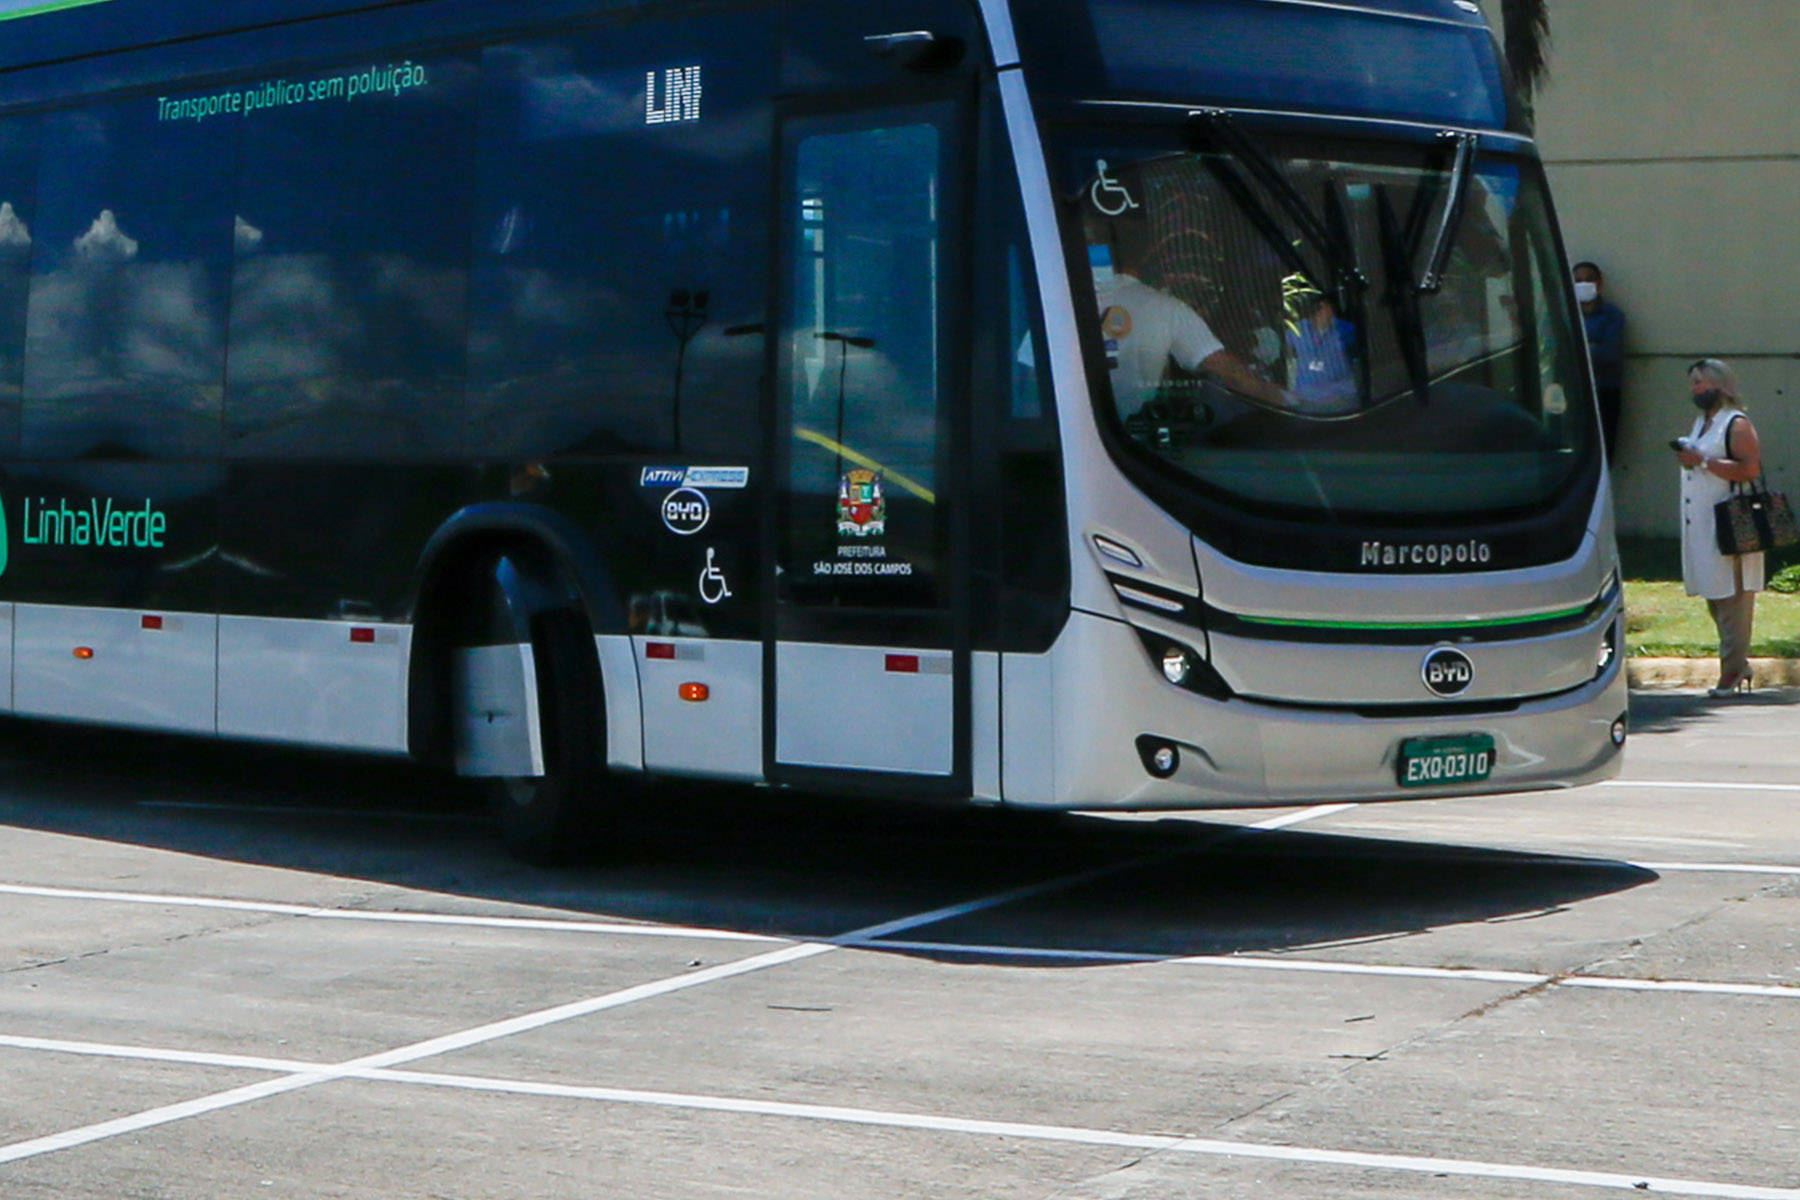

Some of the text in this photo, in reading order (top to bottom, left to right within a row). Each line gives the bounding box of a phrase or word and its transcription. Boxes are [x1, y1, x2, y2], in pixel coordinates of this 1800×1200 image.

[157, 60, 428, 122] Transporte público sem poluição.
[23, 496, 166, 548] LinhaVerde
[666, 502, 703, 520] BYD
[837, 545, 886, 558] PREFEITURA
[1361, 539, 1491, 566] Marcopolo
[813, 560, 832, 575] SÃO
[854, 562, 873, 575] DOS
[874, 562, 913, 575] CAMPOS
[1429, 661, 1470, 683] BYD
